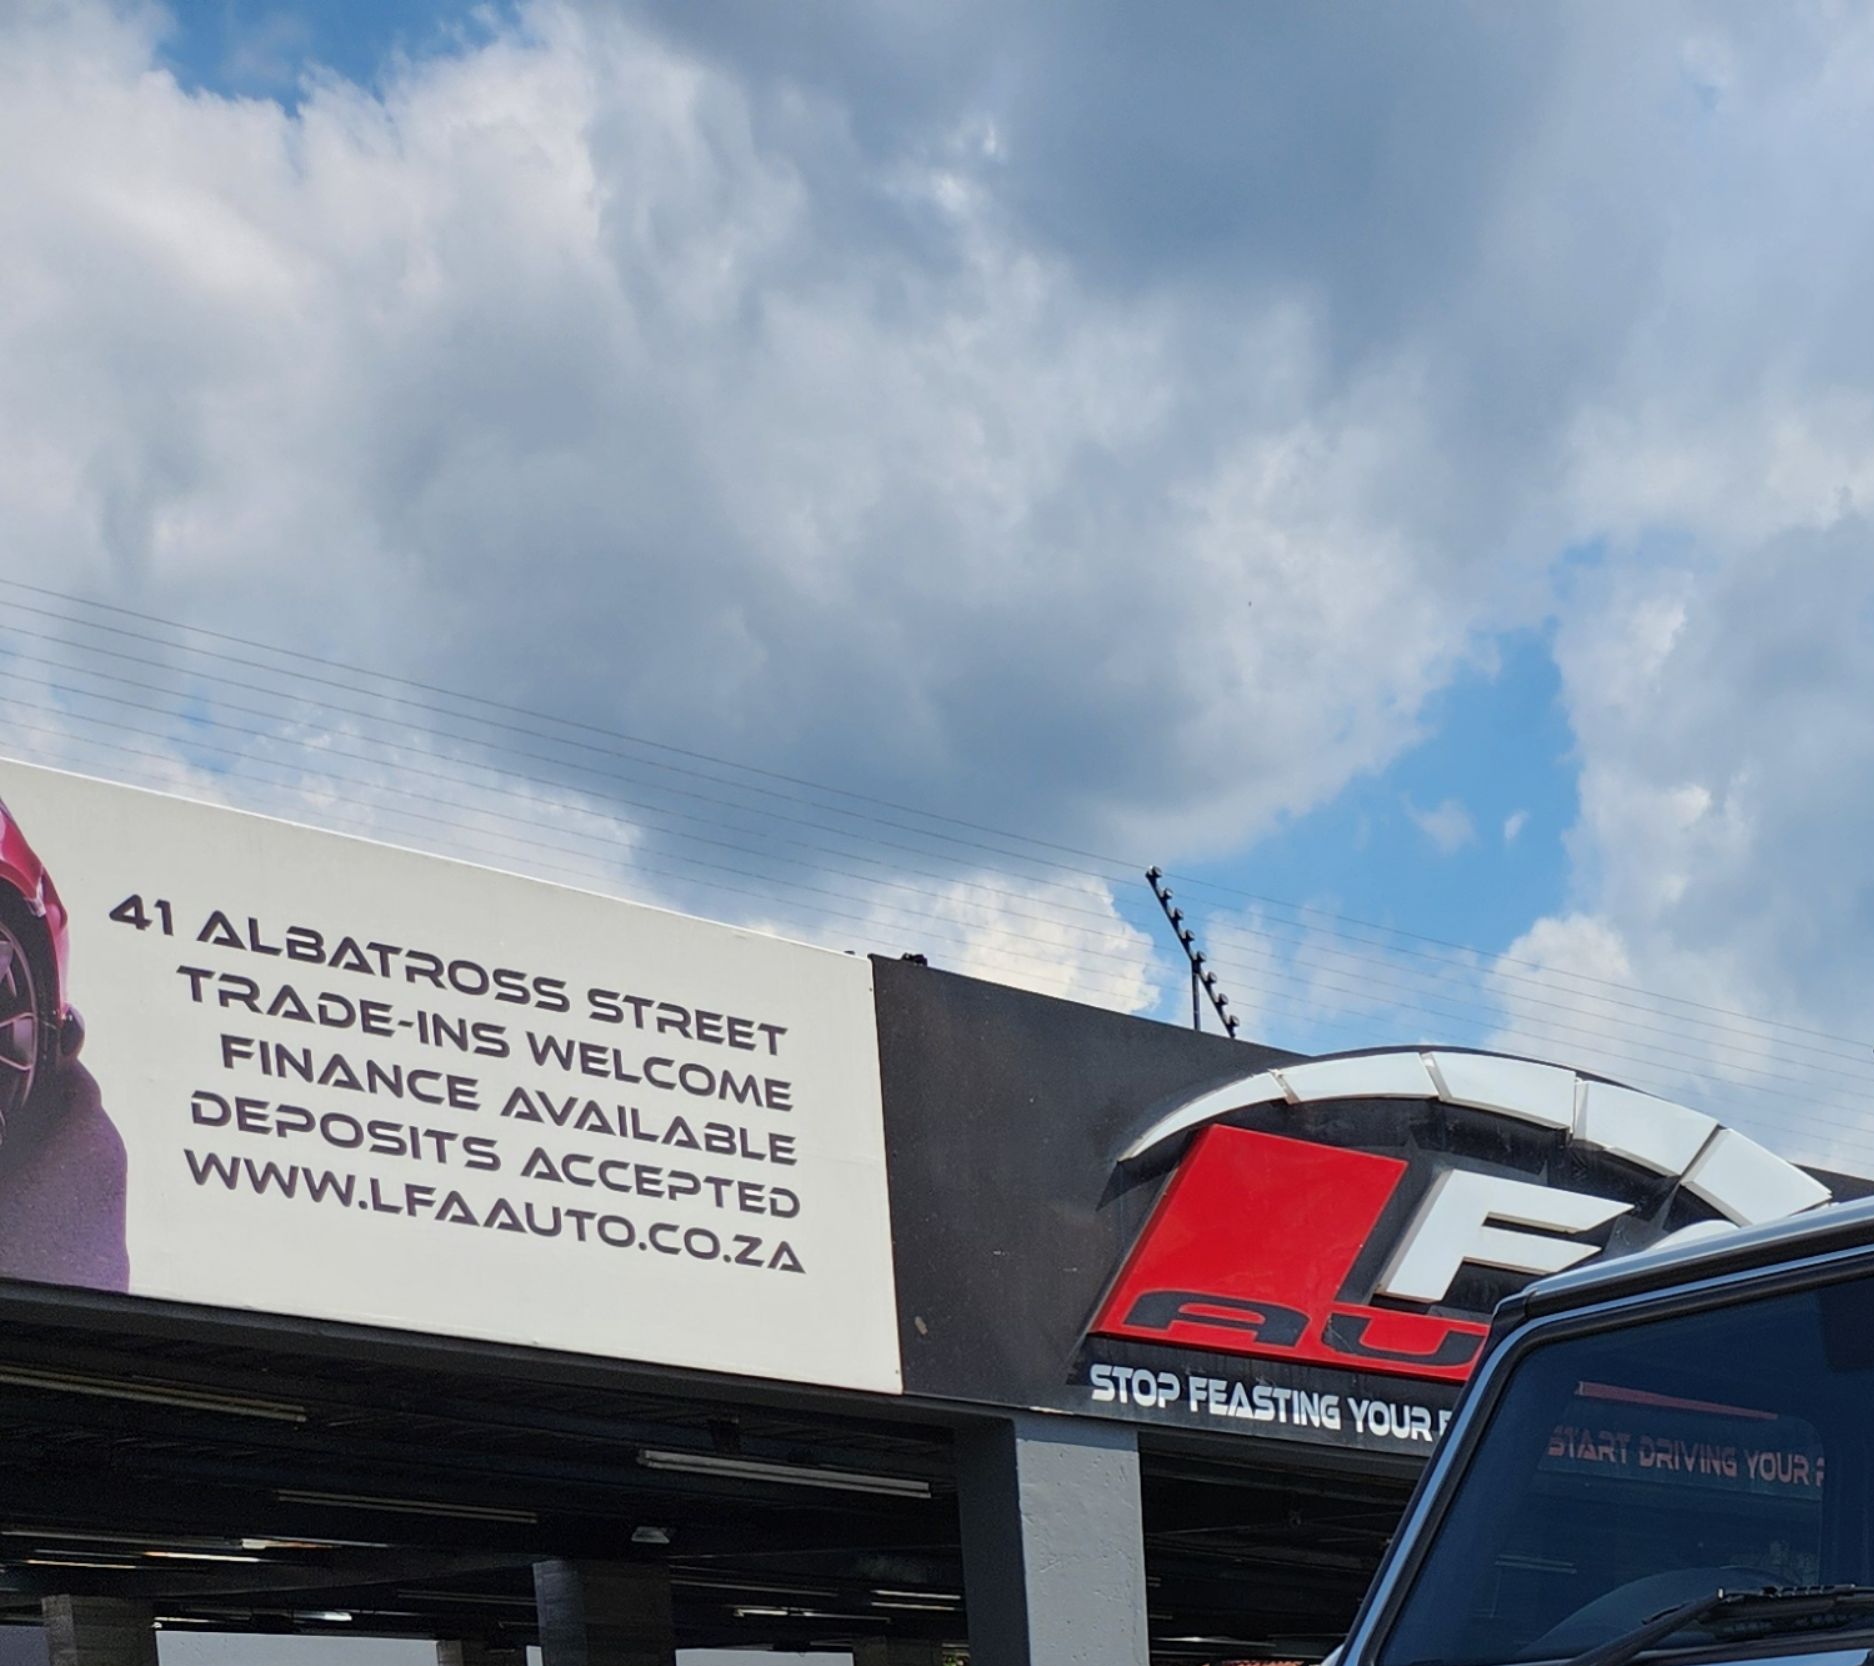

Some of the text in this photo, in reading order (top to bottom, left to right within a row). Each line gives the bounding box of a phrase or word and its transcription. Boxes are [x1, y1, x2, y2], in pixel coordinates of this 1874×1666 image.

[109, 893, 788, 1057] 41 ALBATROSS STREET
[176, 965, 794, 1113] TRADE-INS WELCOME
[190, 1090, 801, 1219] DEPOSITS ACCEPTED
[220, 1033, 798, 1166] FINANCE AVAILABLE
[183, 1148, 807, 1275] WWW.LFAAUTO.CO.ZA
[1123, 1289, 1489, 1367] AU
[1089, 1363, 1181, 1408] STOP
[1188, 1375, 1342, 1430] FEASTING
[1347, 1396, 1434, 1442] YOUR
[1547, 1425, 1632, 1465] START
[1639, 1434, 1738, 1478] DRIVING
[1746, 1450, 1811, 1487] YOUR
